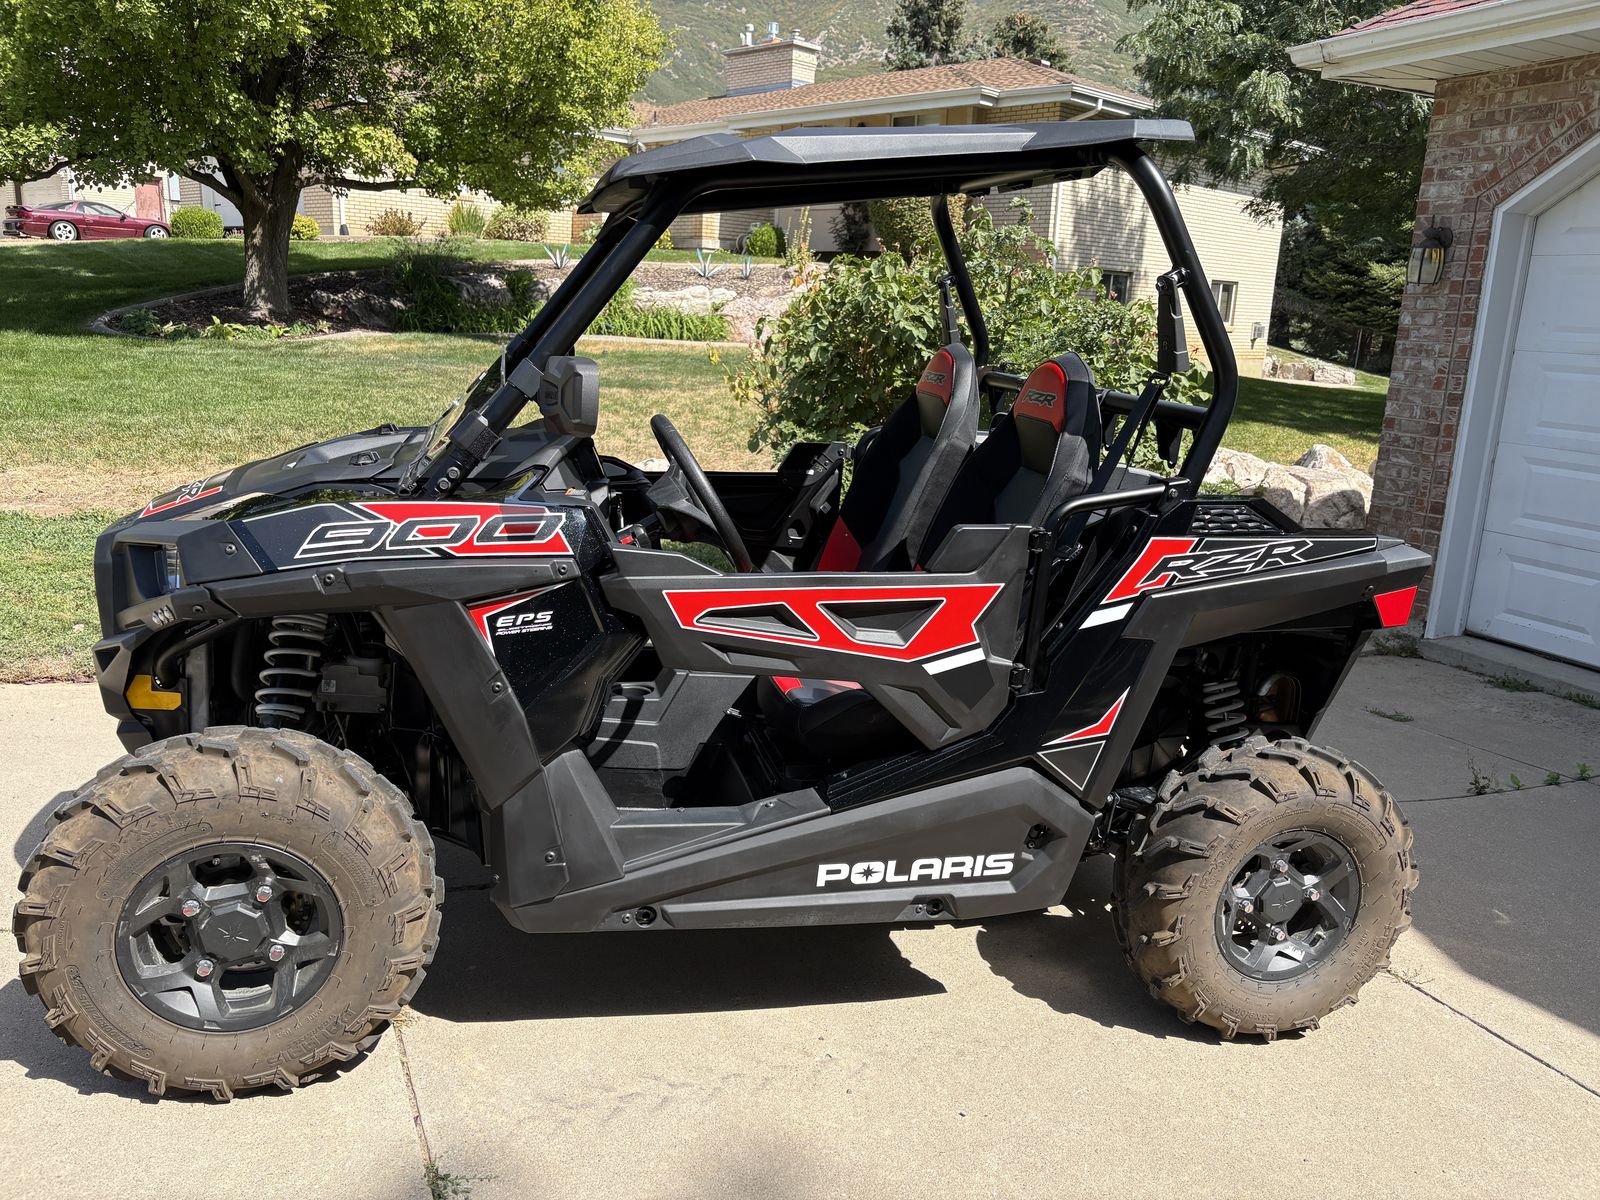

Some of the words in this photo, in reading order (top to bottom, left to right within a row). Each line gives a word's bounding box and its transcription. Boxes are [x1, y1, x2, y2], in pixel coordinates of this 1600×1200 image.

[924, 371, 946, 385] RZR
[1023, 389, 1057, 408] RZR
[294, 513, 567, 559] 900
[1134, 538, 1314, 589] RZR
[496, 611, 554, 627] EPS
[521, 625, 553, 634] STEERING
[816, 853, 1015, 887] POLARIS
